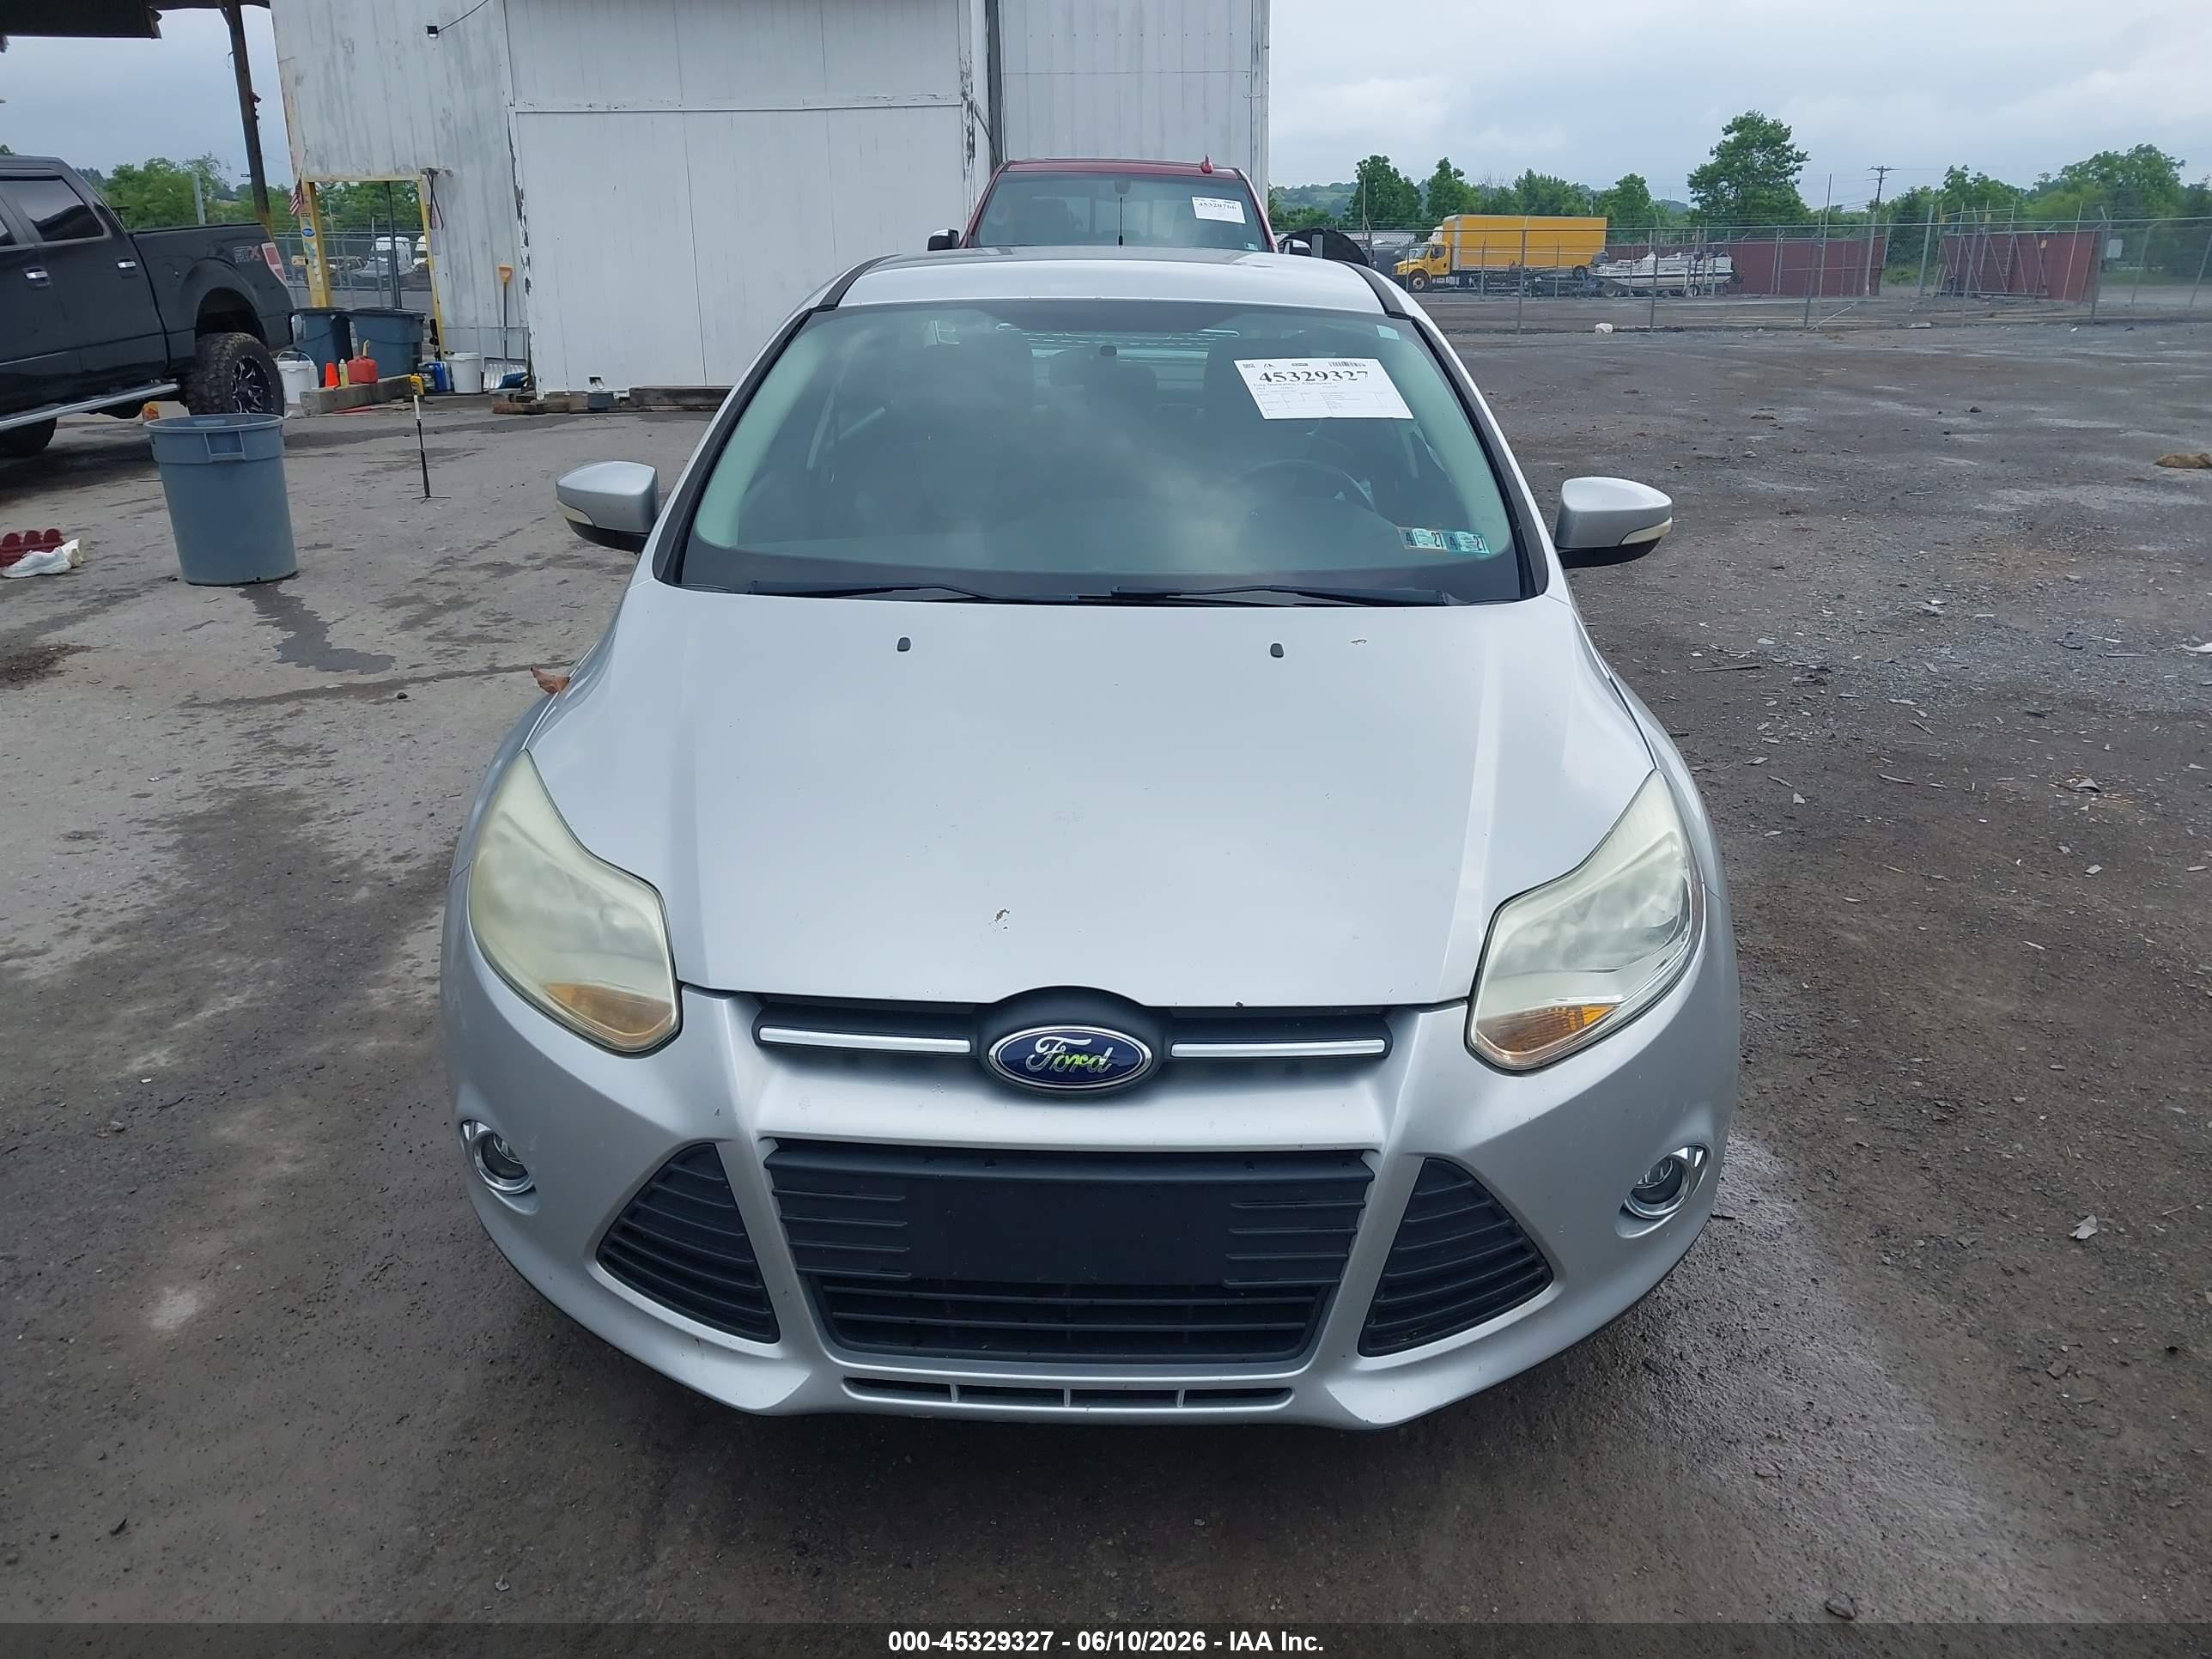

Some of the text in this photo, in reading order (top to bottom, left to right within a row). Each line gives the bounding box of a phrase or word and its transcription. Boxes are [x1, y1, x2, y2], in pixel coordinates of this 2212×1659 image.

[233, 246, 262, 261] STX
[1259, 370, 1369, 383] 45329327
[1431, 532, 1444, 549] 27
[1473, 535, 1488, 551] 27
[1025, 1036, 1114, 1073] Ford
